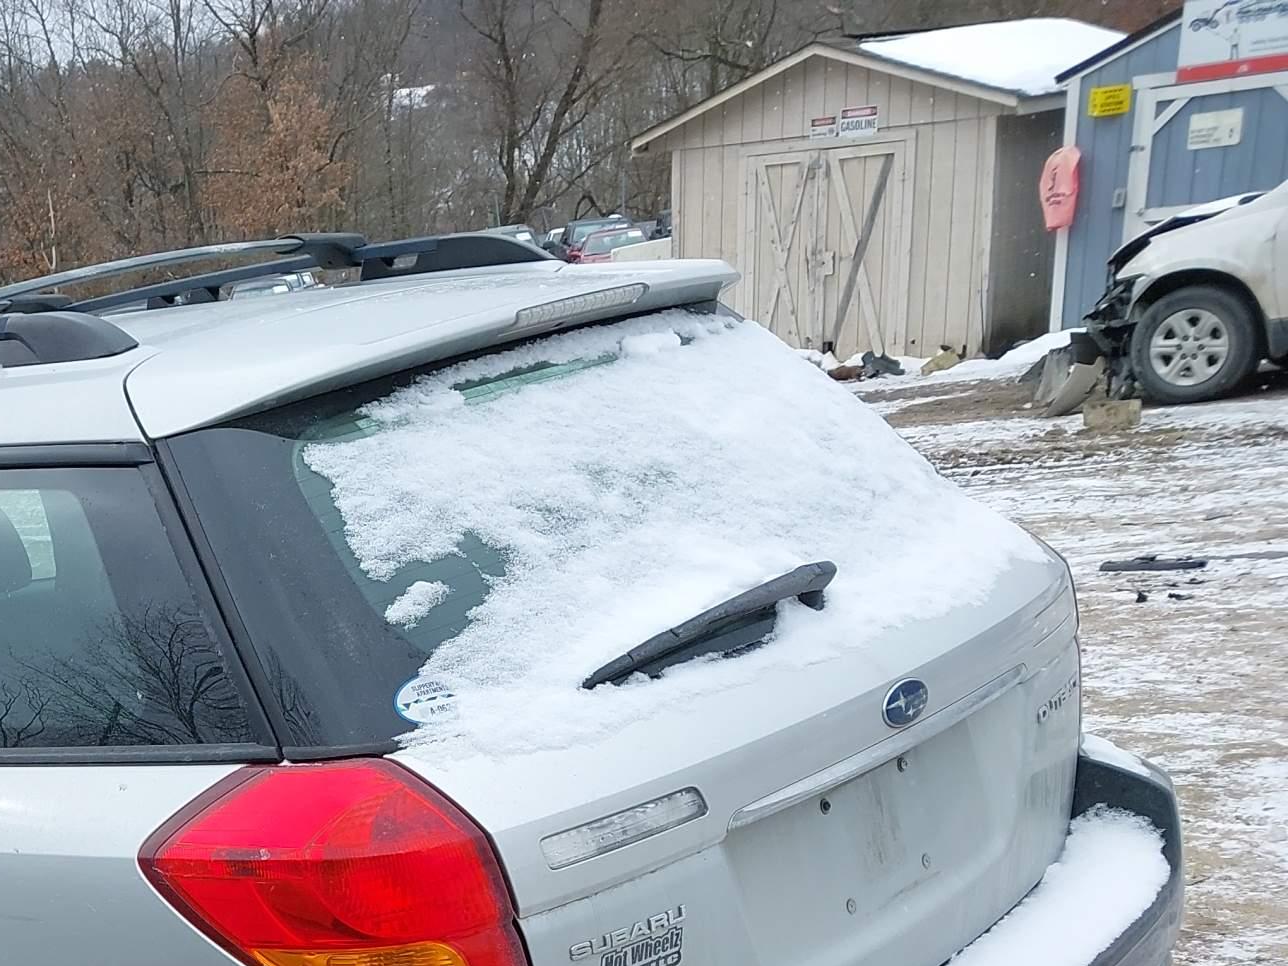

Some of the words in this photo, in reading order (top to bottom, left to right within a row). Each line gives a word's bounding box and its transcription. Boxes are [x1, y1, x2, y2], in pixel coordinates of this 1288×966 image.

[840, 118, 877, 132] GASOLINE
[411, 682, 435, 692] SLIPPERY
[569, 904, 686, 961] SUBARU
[631, 930, 681, 965] Wheelz
